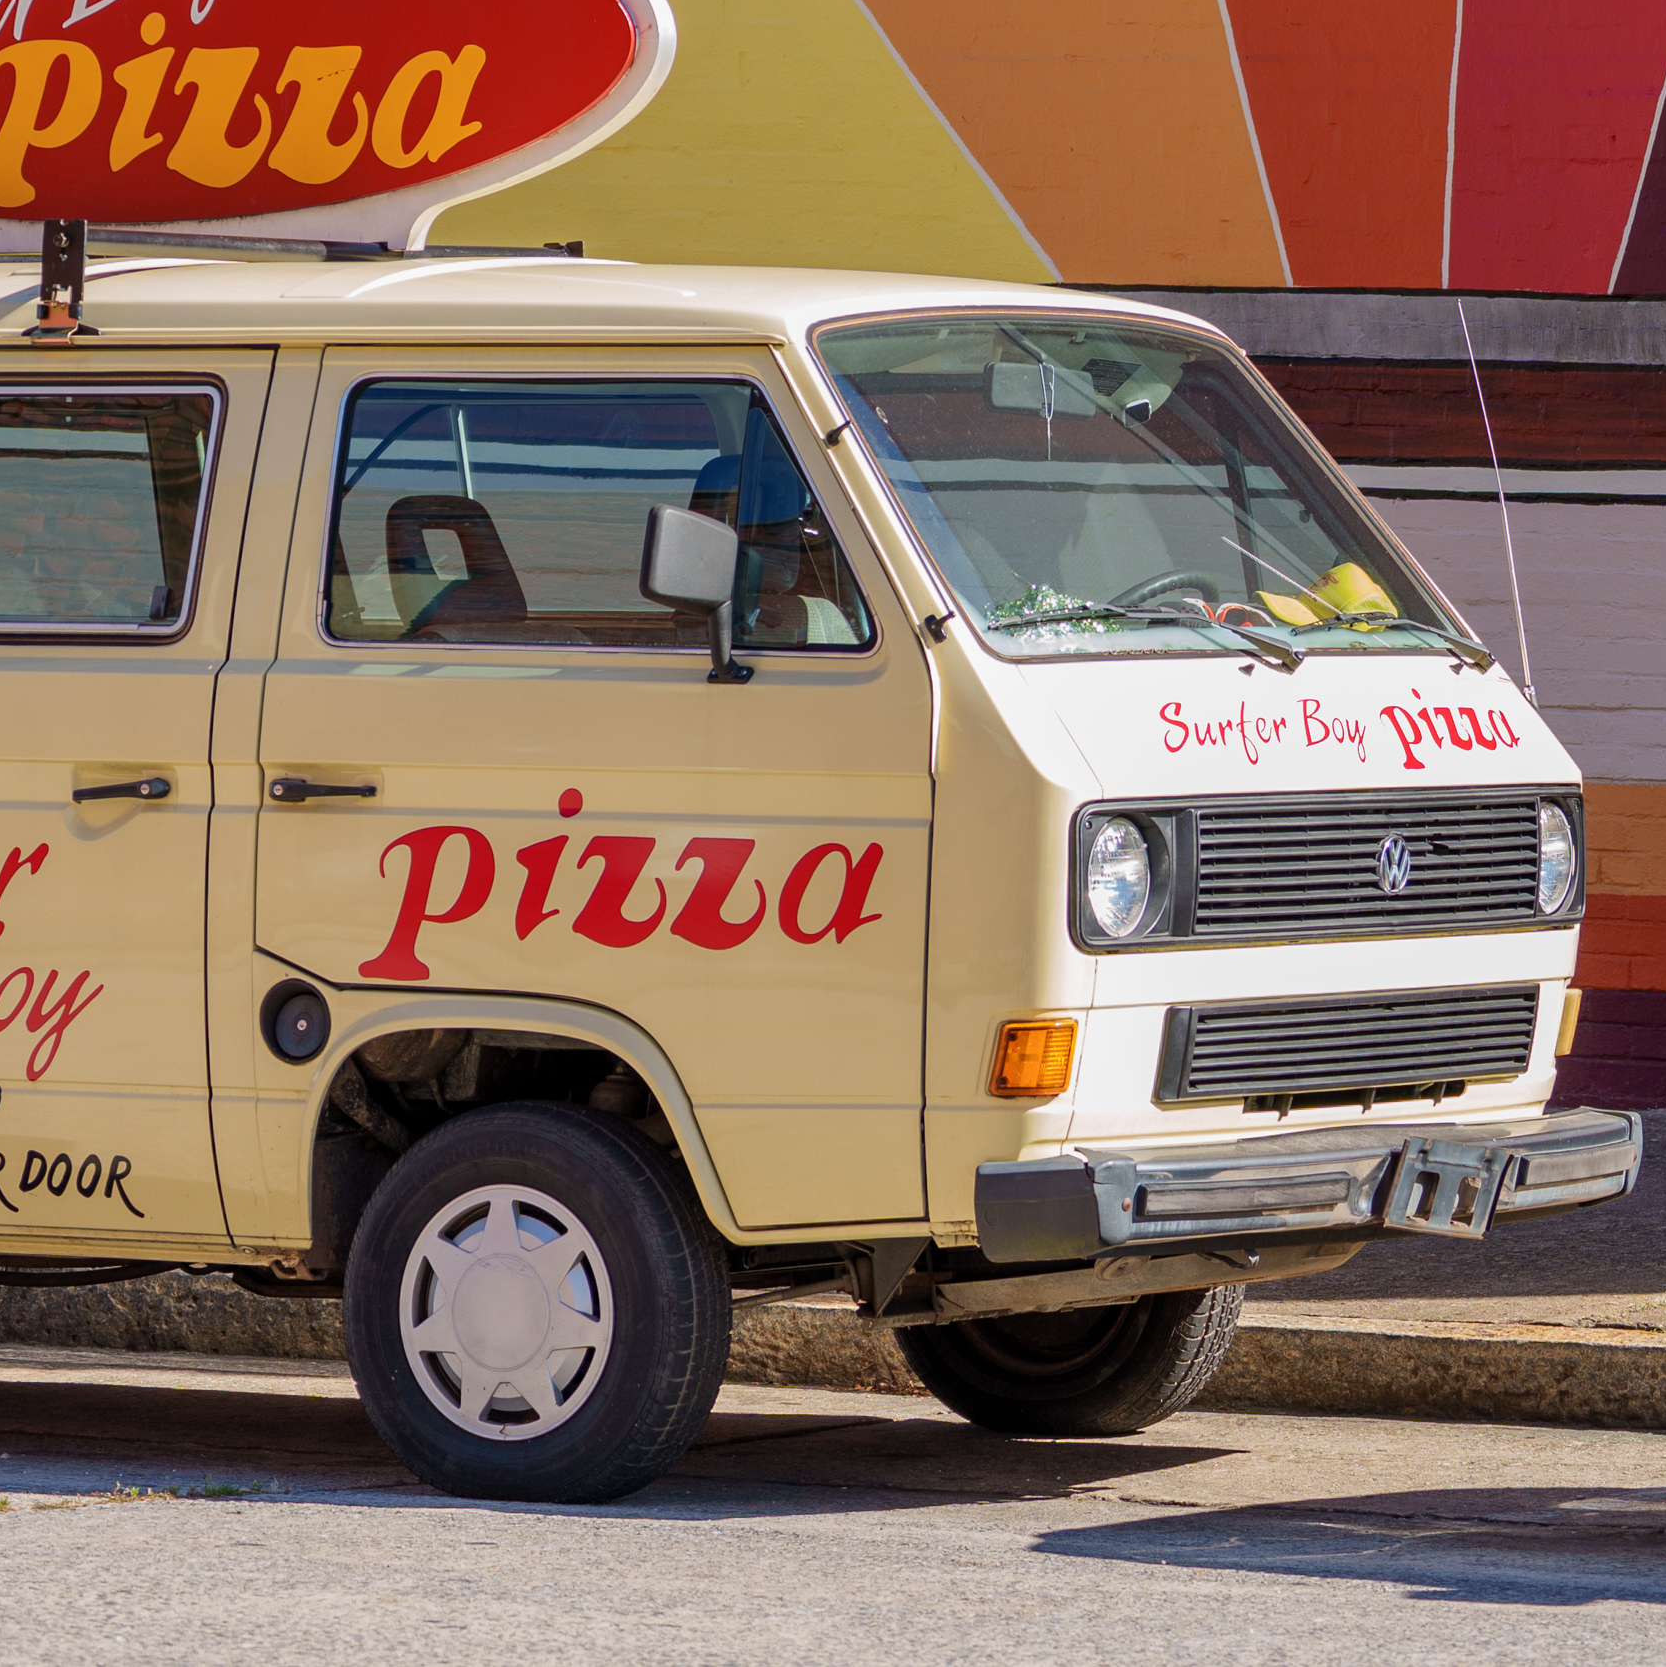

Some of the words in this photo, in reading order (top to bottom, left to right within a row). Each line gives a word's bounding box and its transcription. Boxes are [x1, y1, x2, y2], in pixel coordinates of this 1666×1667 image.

[1159, 701, 1287, 765] Surfer
[1296, 698, 1367, 763] Boy
[1379, 688, 1521, 770] pizza
[358, 787, 884, 981] pizza
[19, 1152, 145, 1219] DOOR
